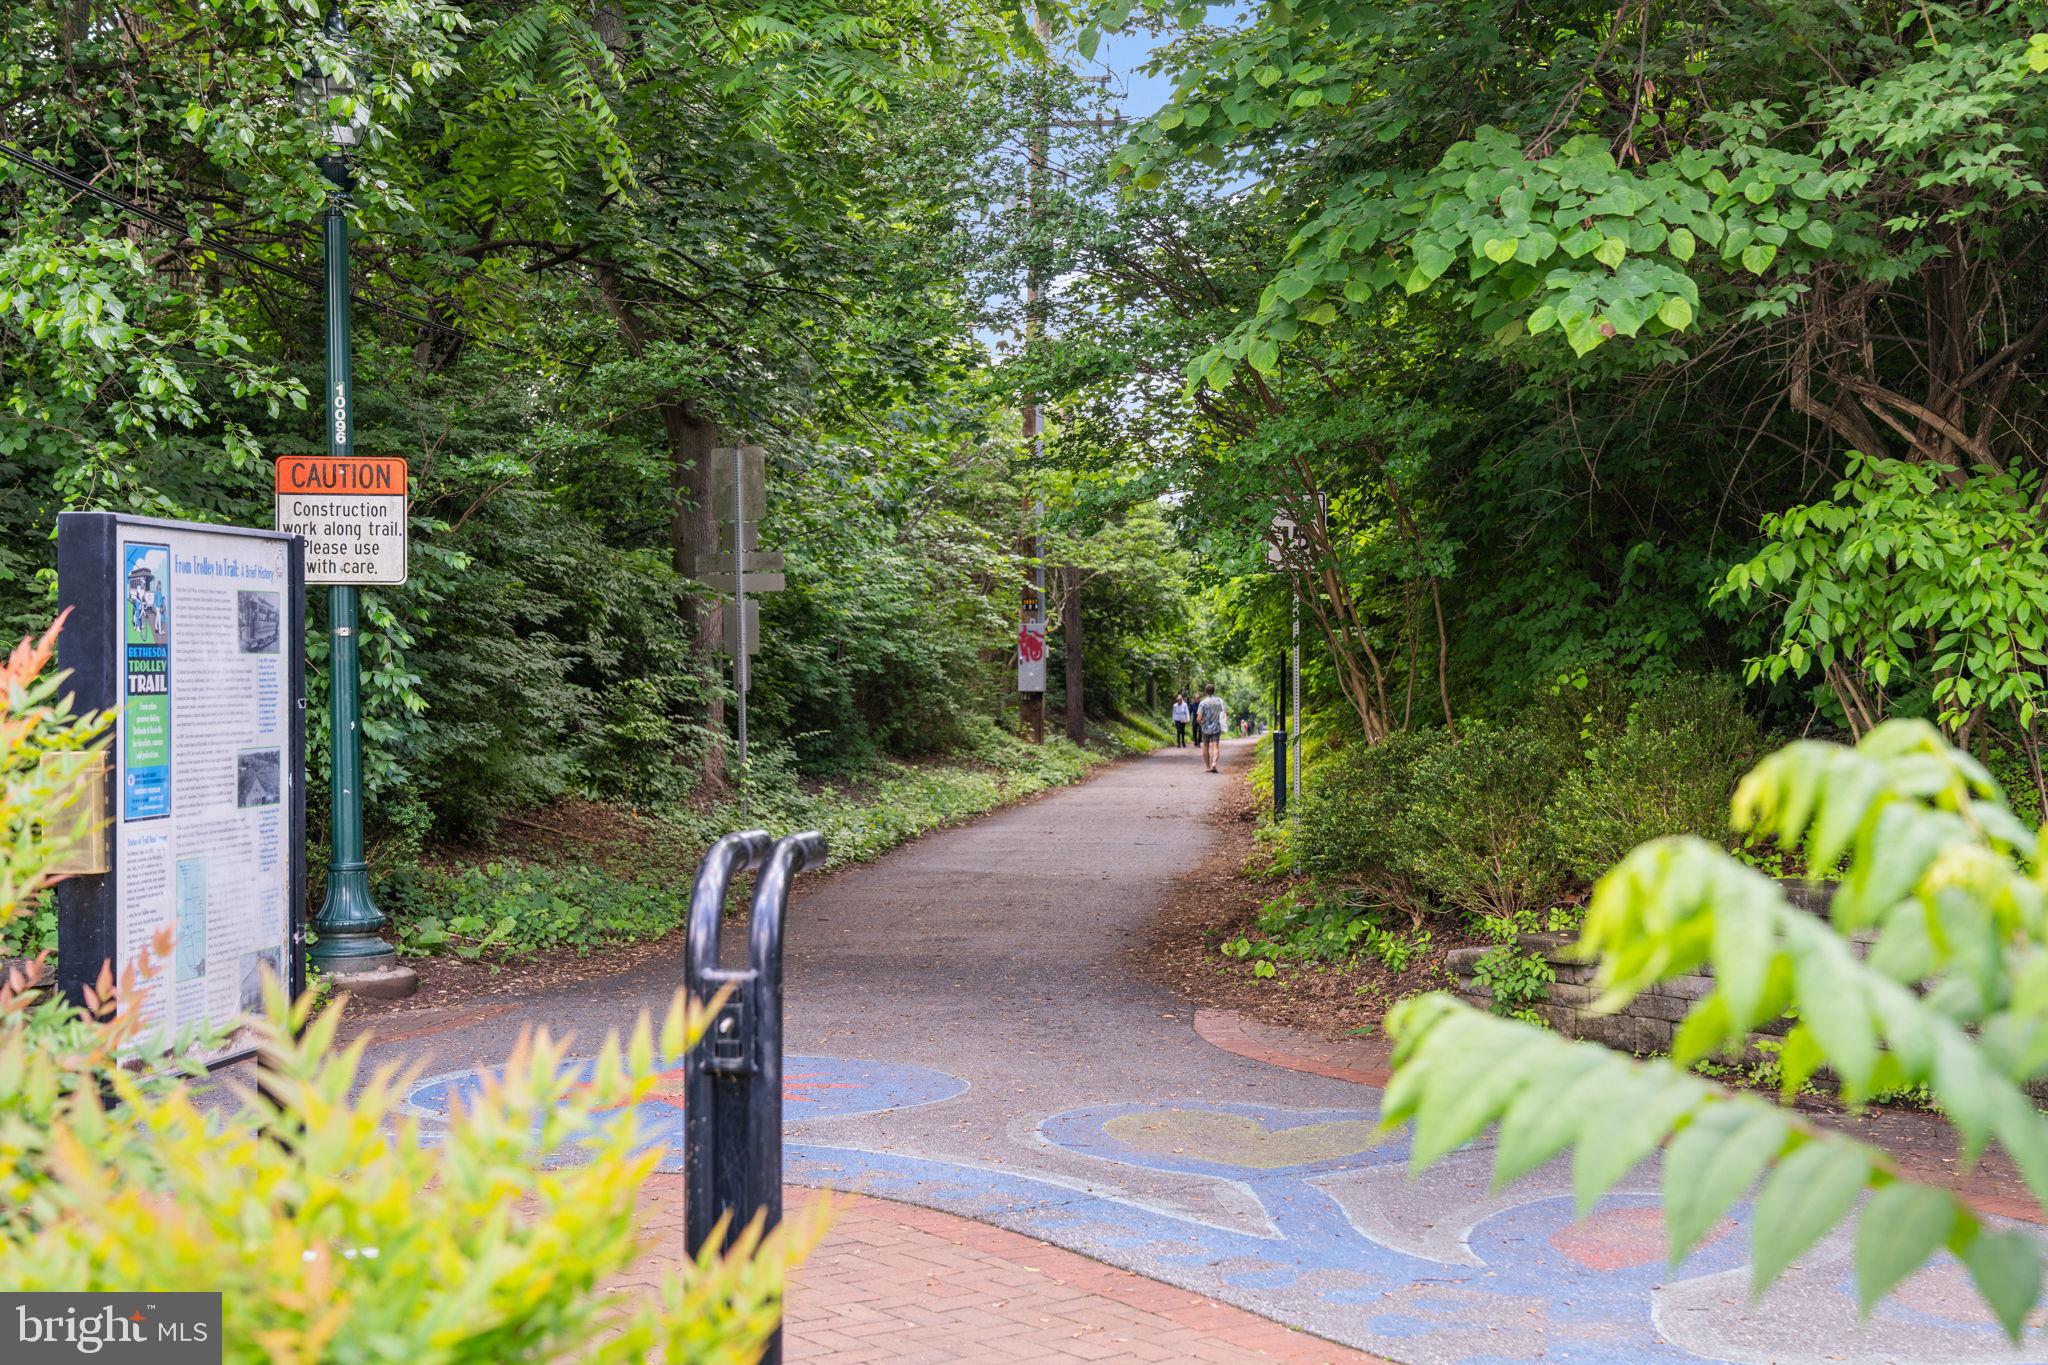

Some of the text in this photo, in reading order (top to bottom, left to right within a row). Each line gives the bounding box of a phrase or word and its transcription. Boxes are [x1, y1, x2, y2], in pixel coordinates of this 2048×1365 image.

[335, 384, 346, 445] 10096
[291, 463, 391, 489] CAUTION
[293, 501, 387, 517] Construction
[282, 521, 402, 540] work along trail.
[354, 543, 380, 555] use
[175, 554, 192, 574] From
[193, 555, 214, 578] Trolley
[215, 560, 223, 576] to
[258, 566, 274, 582] History
[306, 560, 378, 575] with care.
[128, 646, 167, 658] BETHESDA
[128, 659, 168, 673] TROLLEY
[128, 674, 168, 693] TRAIL
